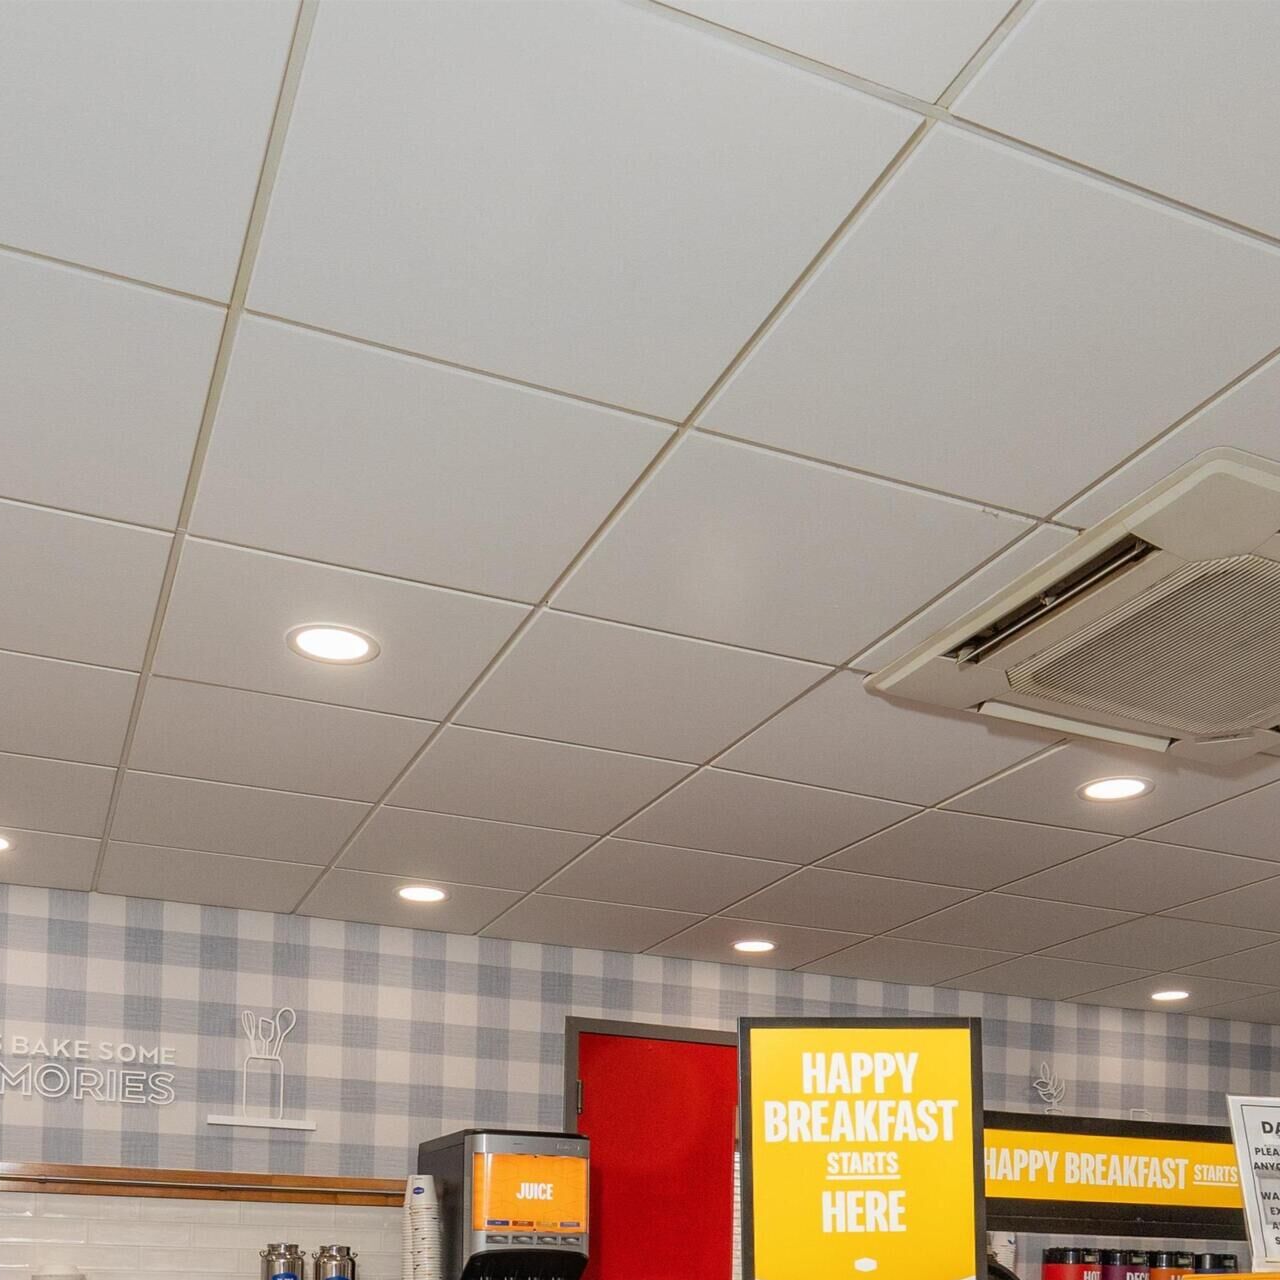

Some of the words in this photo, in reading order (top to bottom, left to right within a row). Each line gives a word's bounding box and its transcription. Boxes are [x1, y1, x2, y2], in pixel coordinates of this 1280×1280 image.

[11, 1035, 90, 1060] BAKE
[98, 1042, 177, 1066] SOME
[801, 1051, 919, 1094] HAPPY
[763, 1098, 959, 1143] BREAKFAST
[826, 1151, 899, 1174] STARTS
[983, 1147, 1059, 1183] HAPPY
[1065, 1151, 1189, 1190] BREAKFAST
[1193, 1163, 1238, 1183] STARTS
[516, 1182, 554, 1200] JUICE
[821, 1190, 907, 1233] HERE
